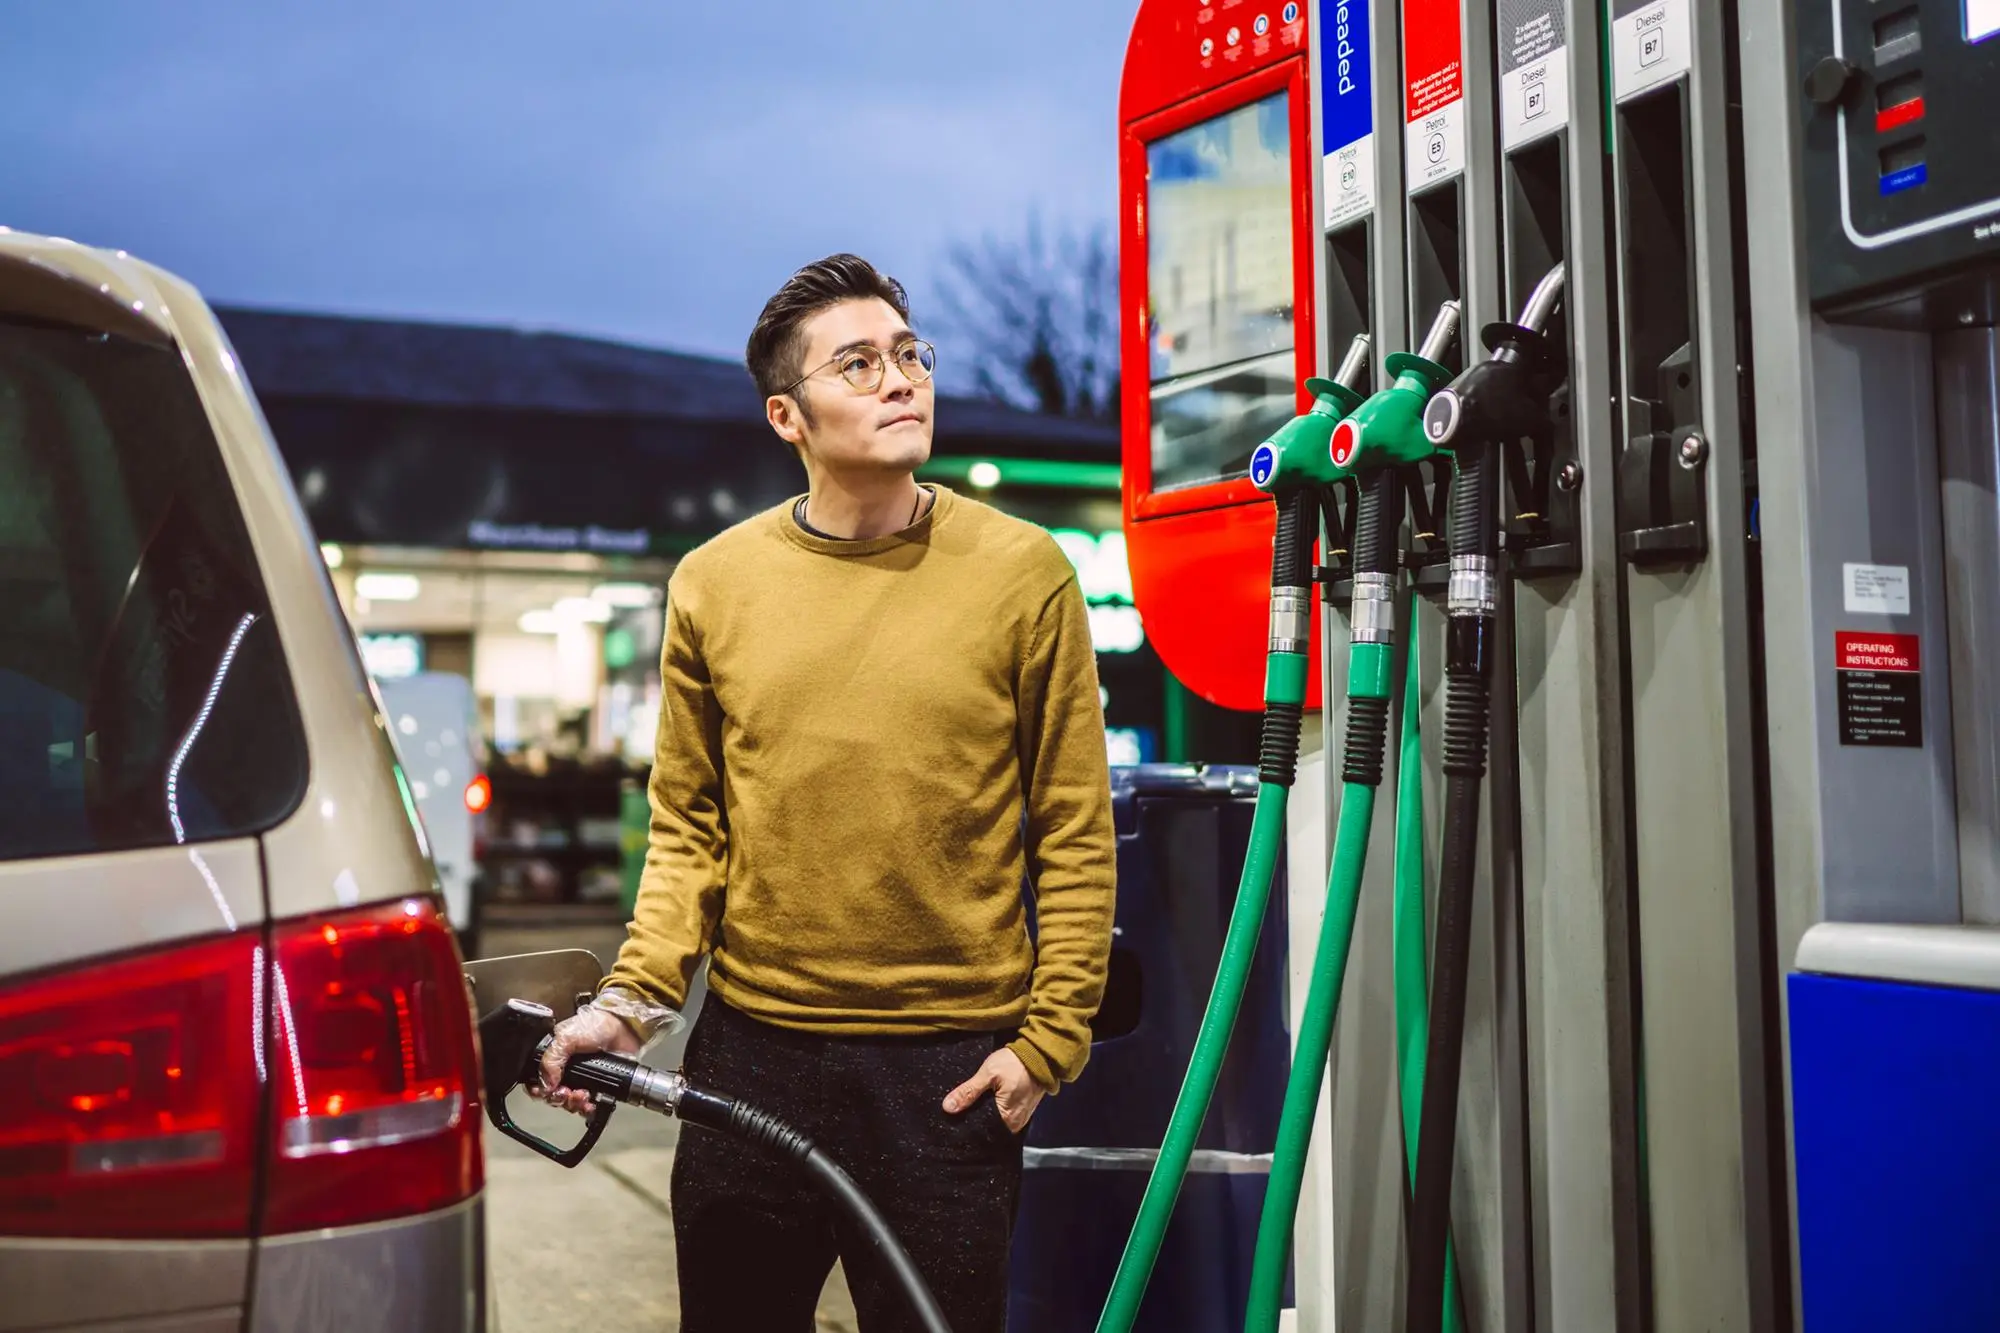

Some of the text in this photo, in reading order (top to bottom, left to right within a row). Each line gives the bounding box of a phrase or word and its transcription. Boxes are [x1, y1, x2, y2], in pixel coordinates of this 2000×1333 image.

[1636, 7, 1665, 31] Diesel
[1645, 39, 1657, 55] B7
[1521, 63, 1546, 85] Diesel
[1529, 93, 1540, 108] B7
[1425, 113, 1446, 133] Petrol
[1431, 141, 1442, 155] E5
[1846, 642, 1895, 654] OPERATING
[1846, 655, 1909, 667] INSTRUCTIONS
